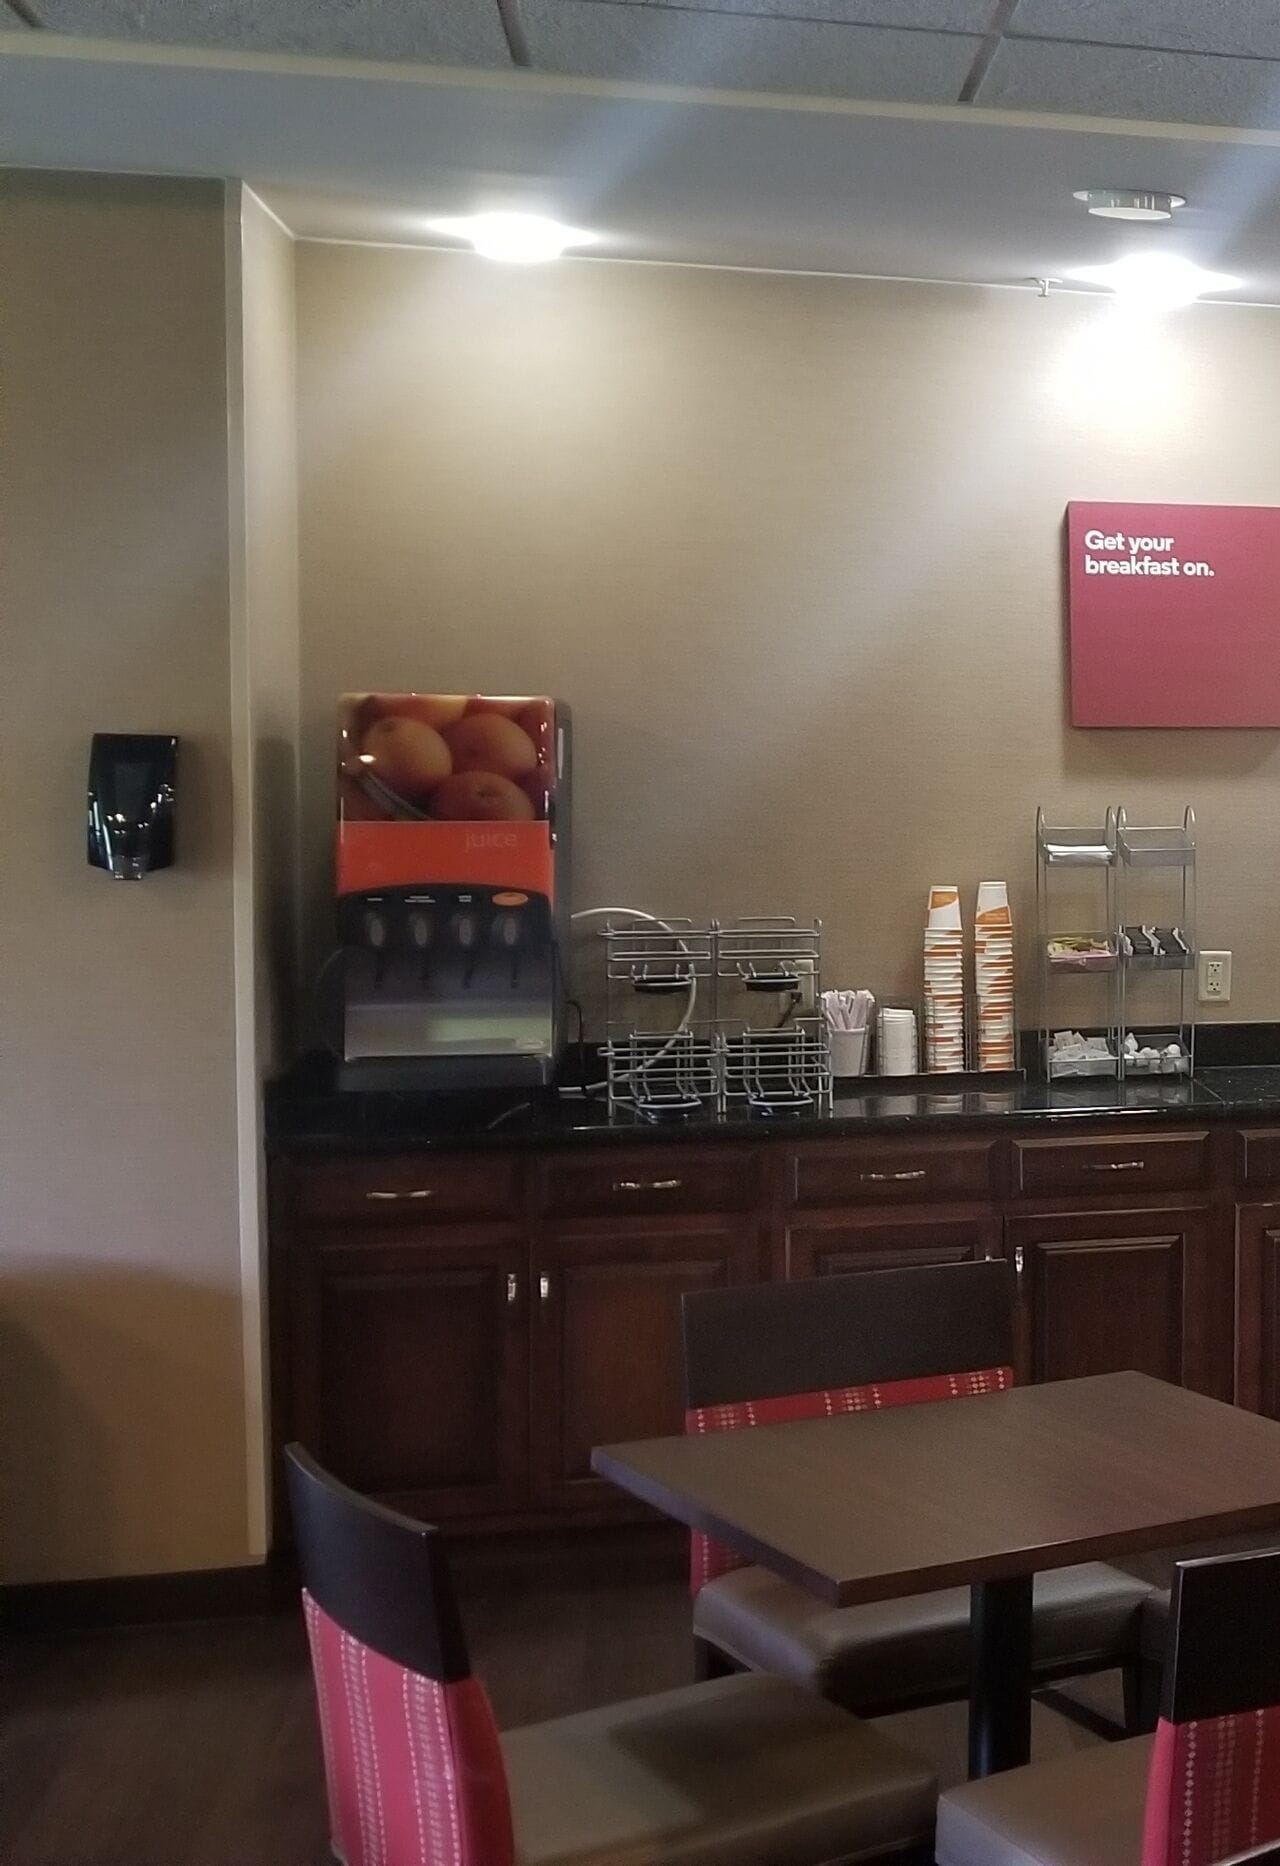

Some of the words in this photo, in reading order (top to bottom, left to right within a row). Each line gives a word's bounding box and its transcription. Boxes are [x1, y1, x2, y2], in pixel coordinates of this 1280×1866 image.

[1084, 530, 1126, 551] Get
[1127, 536, 1175, 555] your
[1084, 554, 1180, 576] breakfast
[1182, 561, 1215, 577] on.
